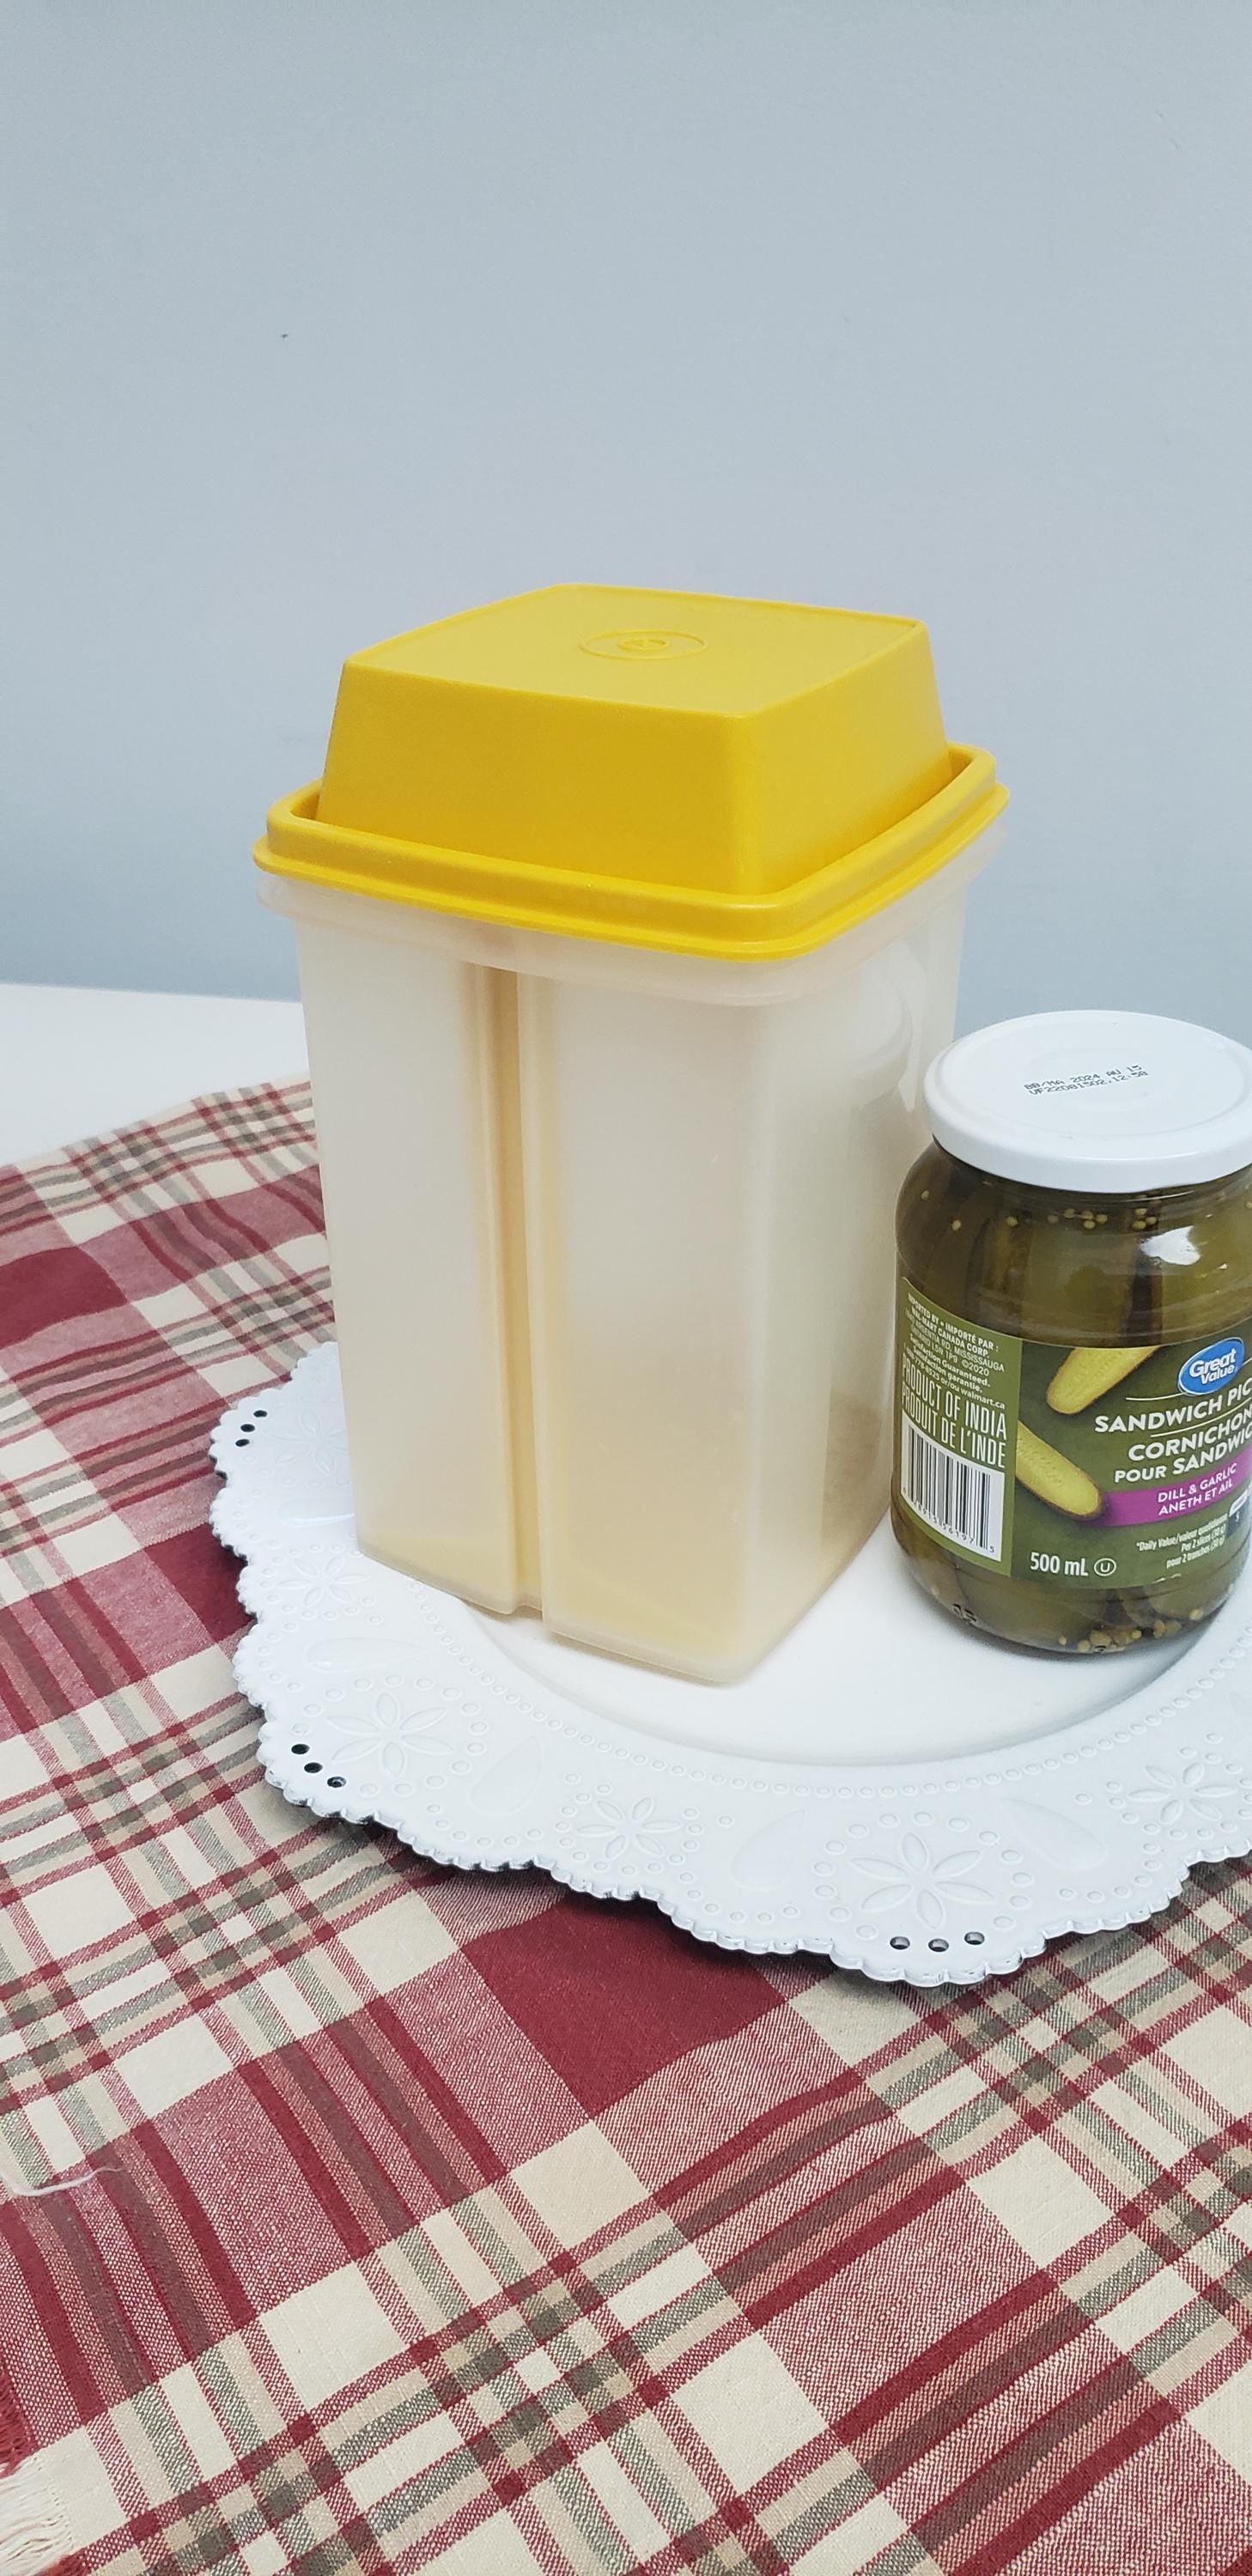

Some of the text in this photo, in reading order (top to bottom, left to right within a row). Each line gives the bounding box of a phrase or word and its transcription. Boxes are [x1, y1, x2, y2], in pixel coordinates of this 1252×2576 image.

[1070, 1073, 1101, 1084] 2024
[938, 1327, 965, 1350] CANADA
[945, 1322, 976, 1345] IMPORTÉ
[978, 1337, 994, 1351] PAR
[942, 1359, 991, 1388] Guaranteed.
[954, 1346, 1005, 1373] MISSISSAUGA
[1188, 1347, 1237, 1378] Great
[902, 1352, 1007, 1442] PRODUCT OF INDIA
[947, 1372, 983, 1394] garantie.
[960, 1387, 1006, 1410] walmart.ca
[902, 1380, 1007, 1469] PRODUIT DE L'INDE
[1094, 1394, 1223, 1433] SANDWICH
[1114, 1465, 1167, 1484] POUR
[1158, 1462, 1237, 1503] DILL & GARLIC
[1158, 1479, 1233, 1516] ANETH ET AIL
[1030, 1551, 1061, 1574] 500
[1064, 1558, 1089, 1577] mL
[1167, 1557, 1182, 1570] pour
